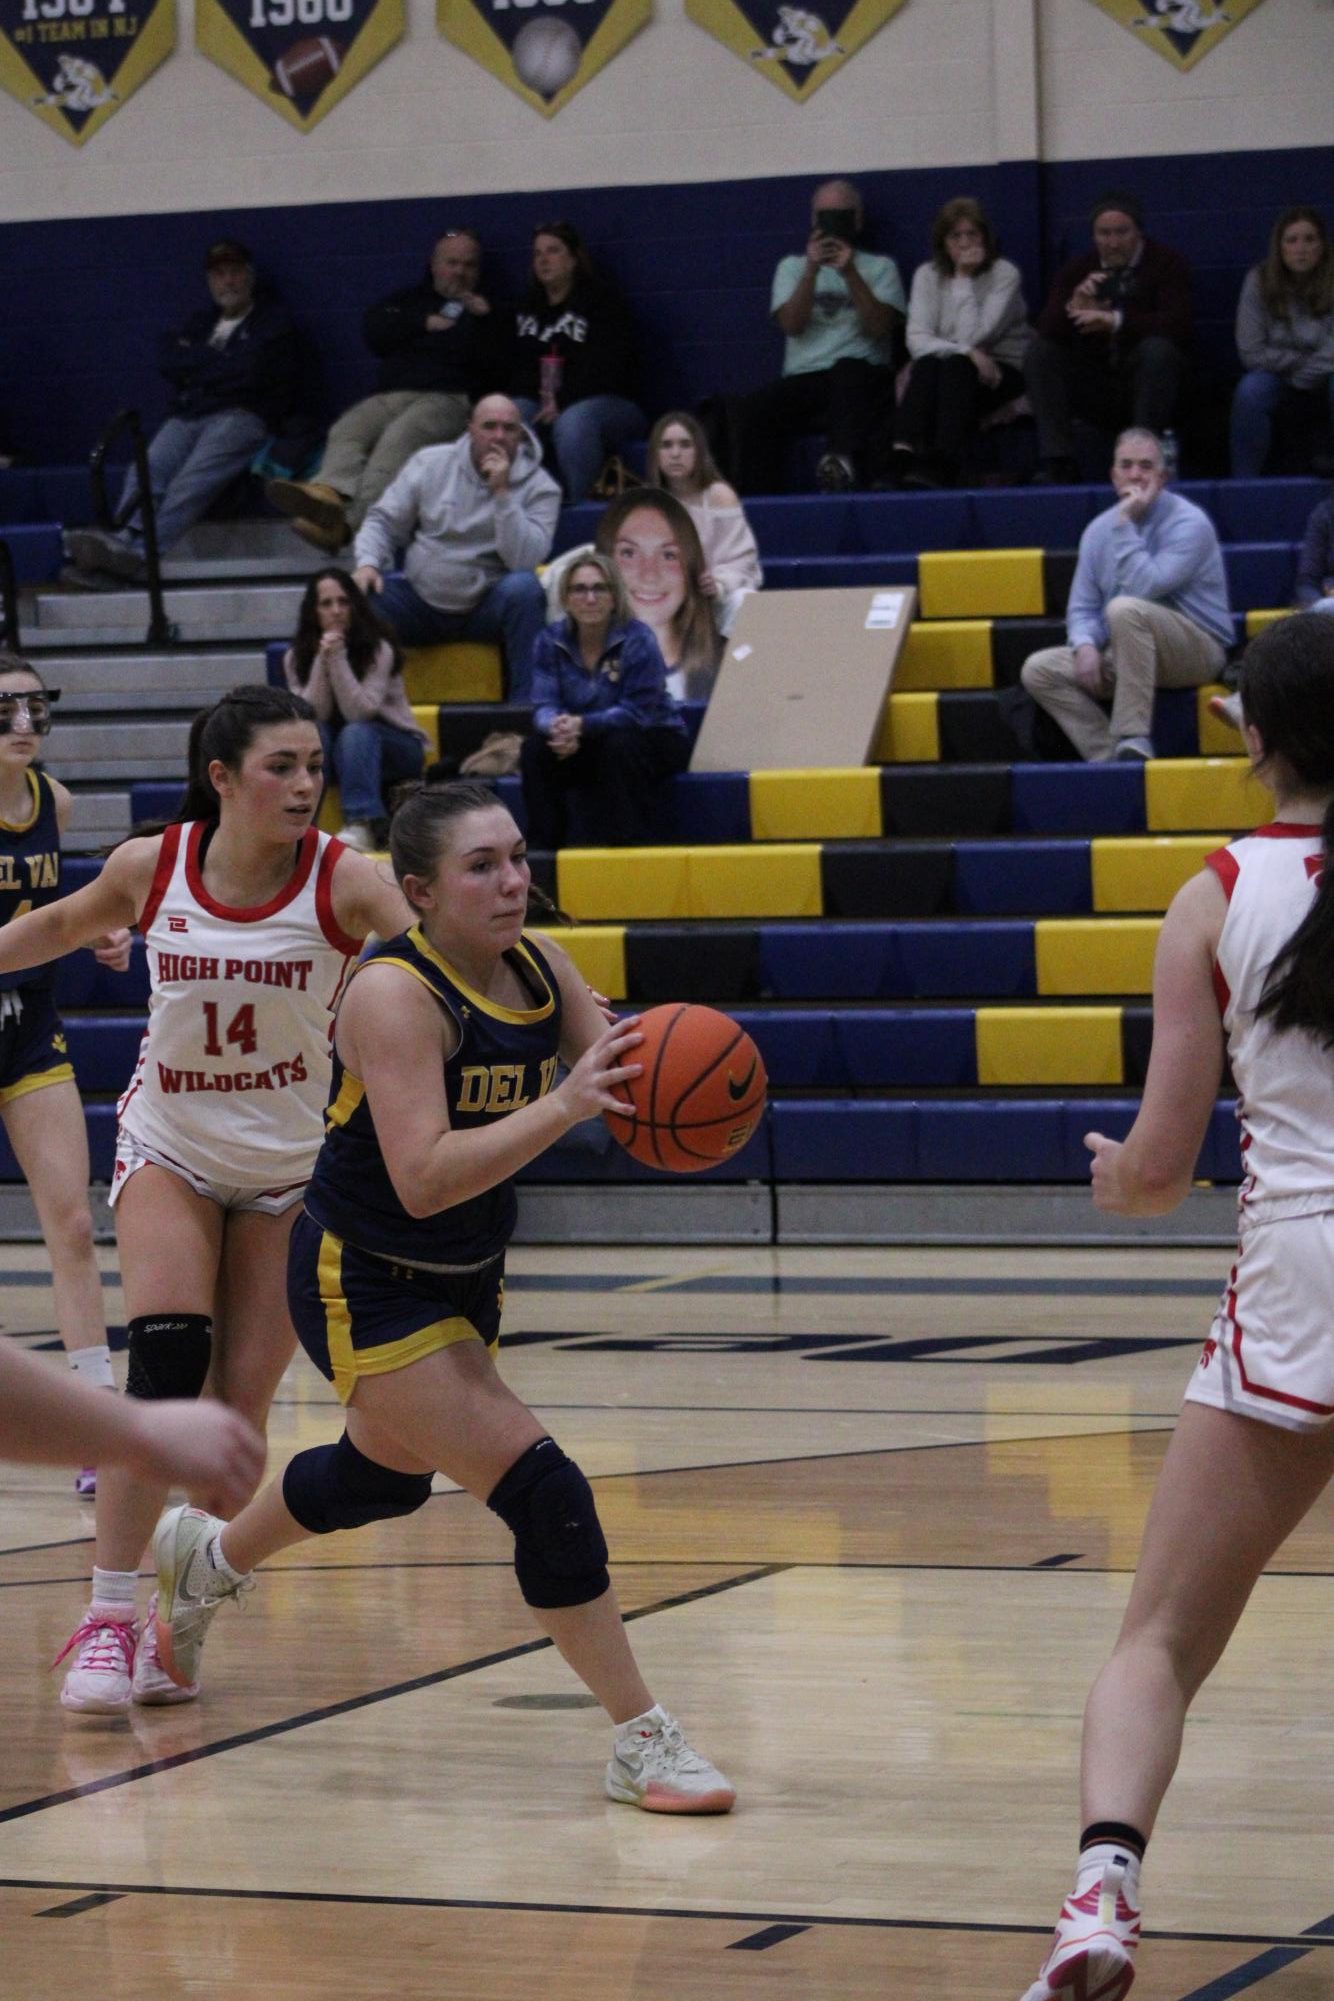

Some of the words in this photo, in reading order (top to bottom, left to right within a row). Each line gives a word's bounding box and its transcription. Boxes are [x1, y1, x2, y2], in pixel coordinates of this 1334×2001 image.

[37, 20, 86, 43] TEAM
[112, 15, 138, 37] NJ
[158, 952, 219, 984] HIGH
[224, 959, 313, 992] POINT
[202, 1001, 258, 1057] 14
[157, 1051, 308, 1094] WILDCATS
[456, 1064, 529, 1112] DEL
